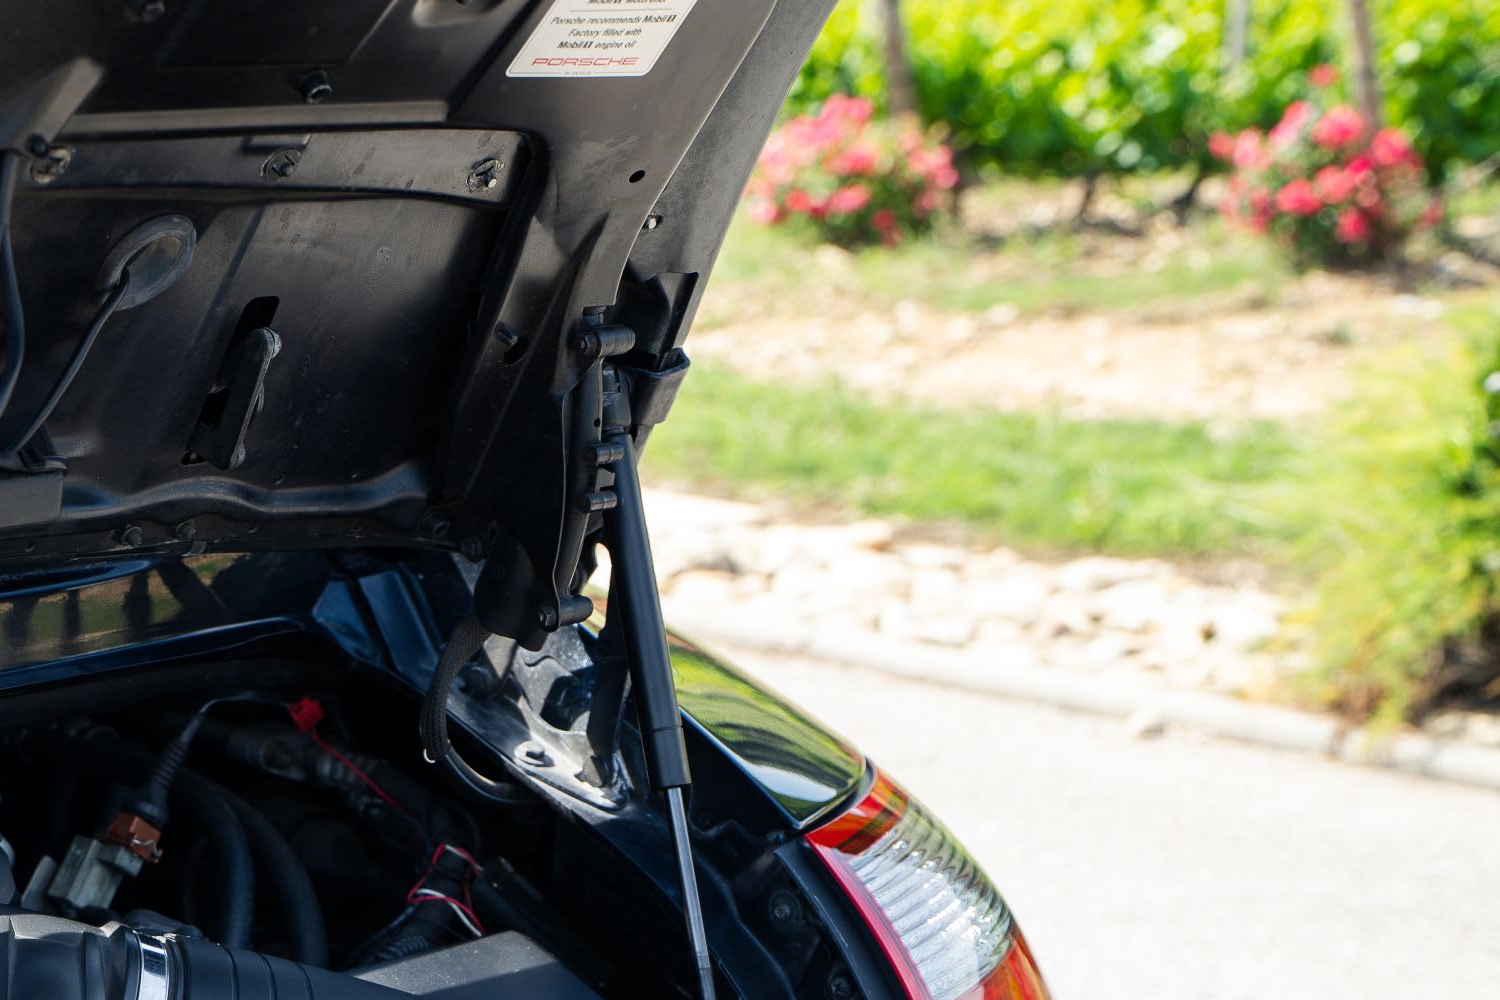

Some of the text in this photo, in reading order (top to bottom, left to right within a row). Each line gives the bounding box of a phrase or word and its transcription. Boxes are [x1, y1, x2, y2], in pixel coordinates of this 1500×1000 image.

[550, 16, 586, 25] Porsche
[587, 15, 641, 24] recommends
[568, 27, 642, 38] Factory filled with
[594, 42, 623, 50] engine
[624, 40, 637, 48] oil
[532, 57, 639, 66] PORSCHE
